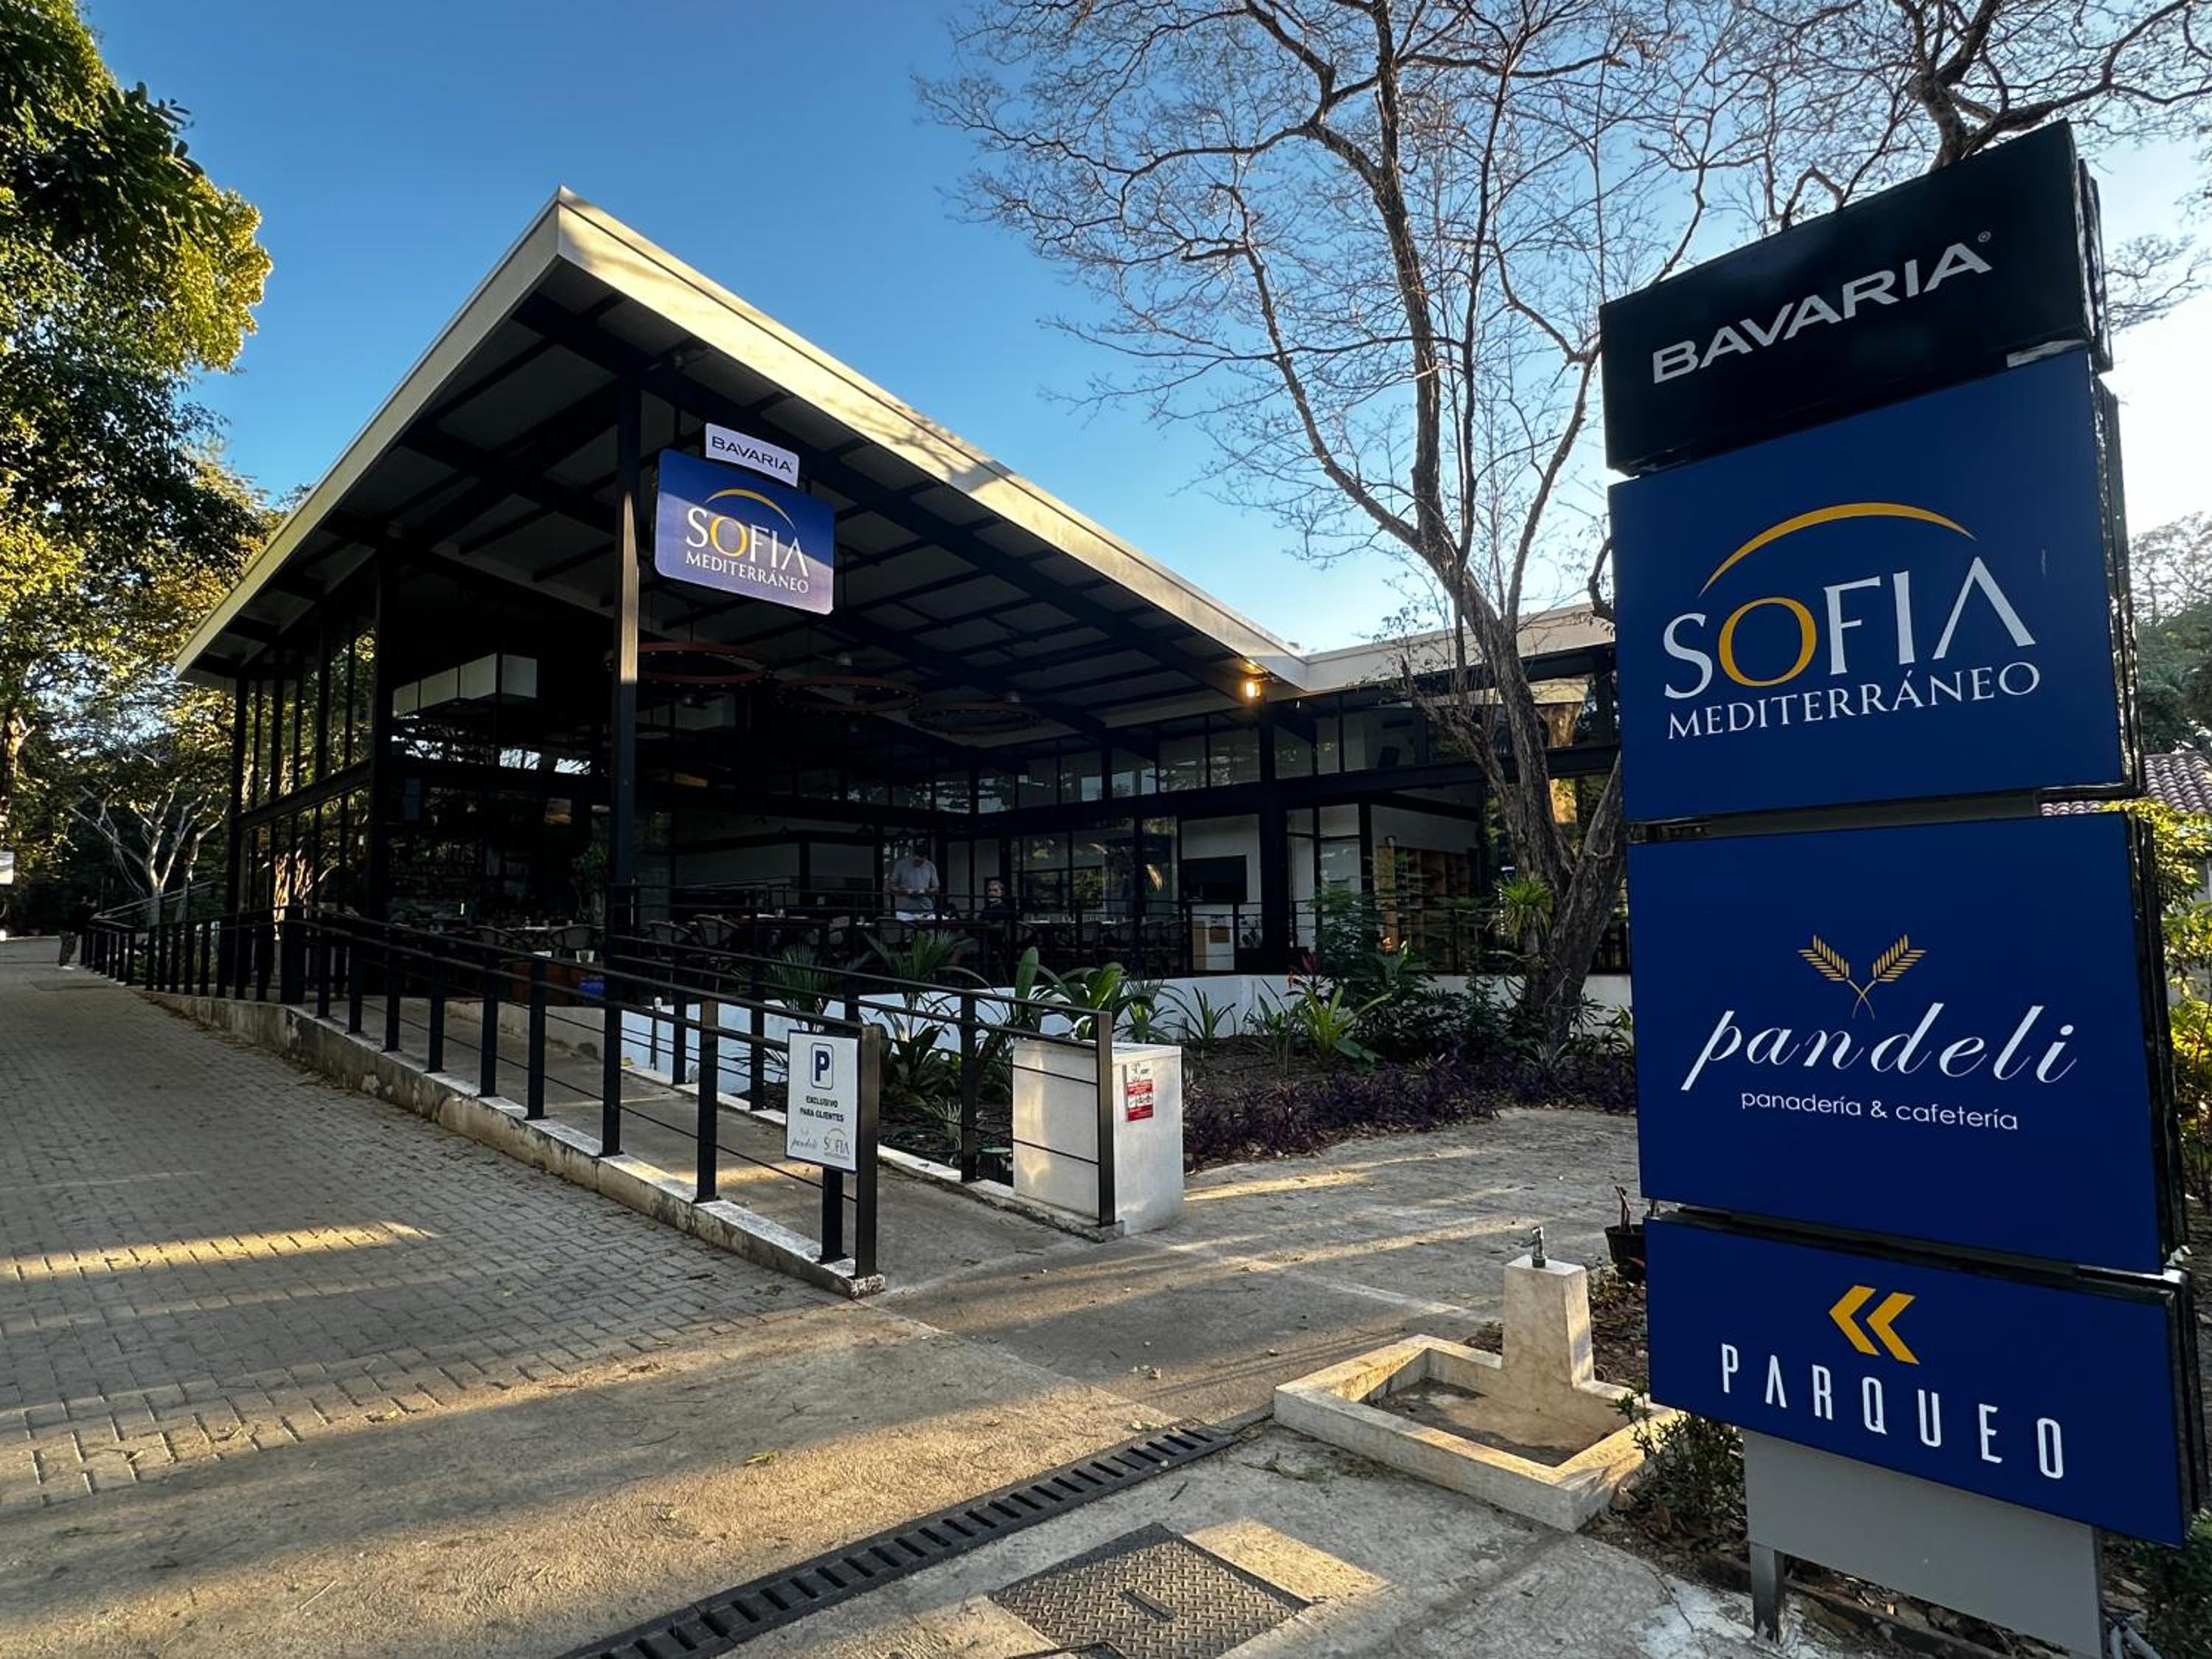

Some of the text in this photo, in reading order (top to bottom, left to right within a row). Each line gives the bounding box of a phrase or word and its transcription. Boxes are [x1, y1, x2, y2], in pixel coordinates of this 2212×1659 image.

[685, 507, 809, 577] SOFIA
[1663, 557, 2037, 700] SOFIA
[1668, 661, 2041, 740] MEDITERRÁNEO
[815, 1049, 830, 1082] P
[1680, 1002, 2078, 1091] pandeli
[799, 1107, 845, 1122] PARA CLIENTES
[805, 1095, 838, 1108] EXCLUSIVO
[1741, 1093, 2019, 1130] panadería & cafetería
[1722, 1343, 2065, 1479] PARQUEO
